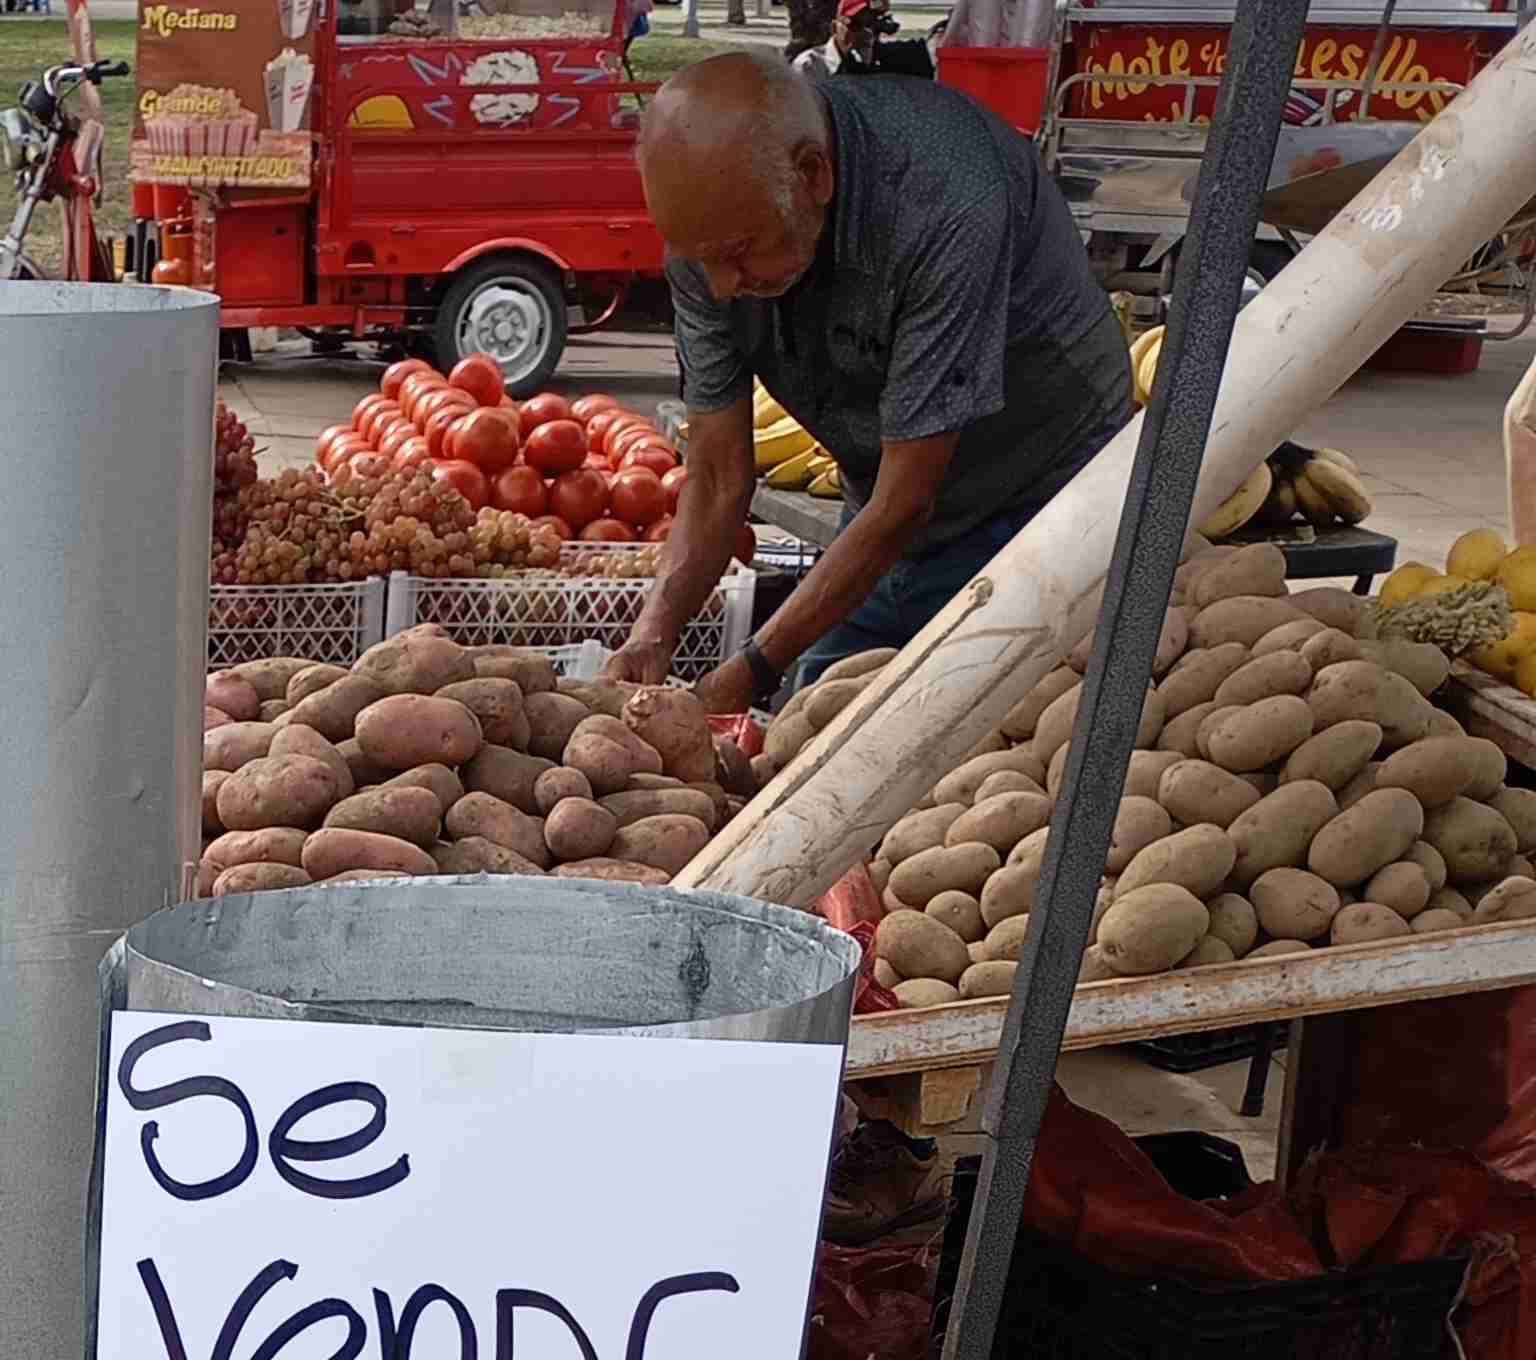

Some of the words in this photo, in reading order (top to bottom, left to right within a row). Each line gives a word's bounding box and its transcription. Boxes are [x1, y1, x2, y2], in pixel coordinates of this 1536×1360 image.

[141, 5, 238, 37] Mediana
[1090, 36, 1191, 109] Mote
[139, 89, 224, 120] Grande
[117, 1020, 412, 1201] Se
